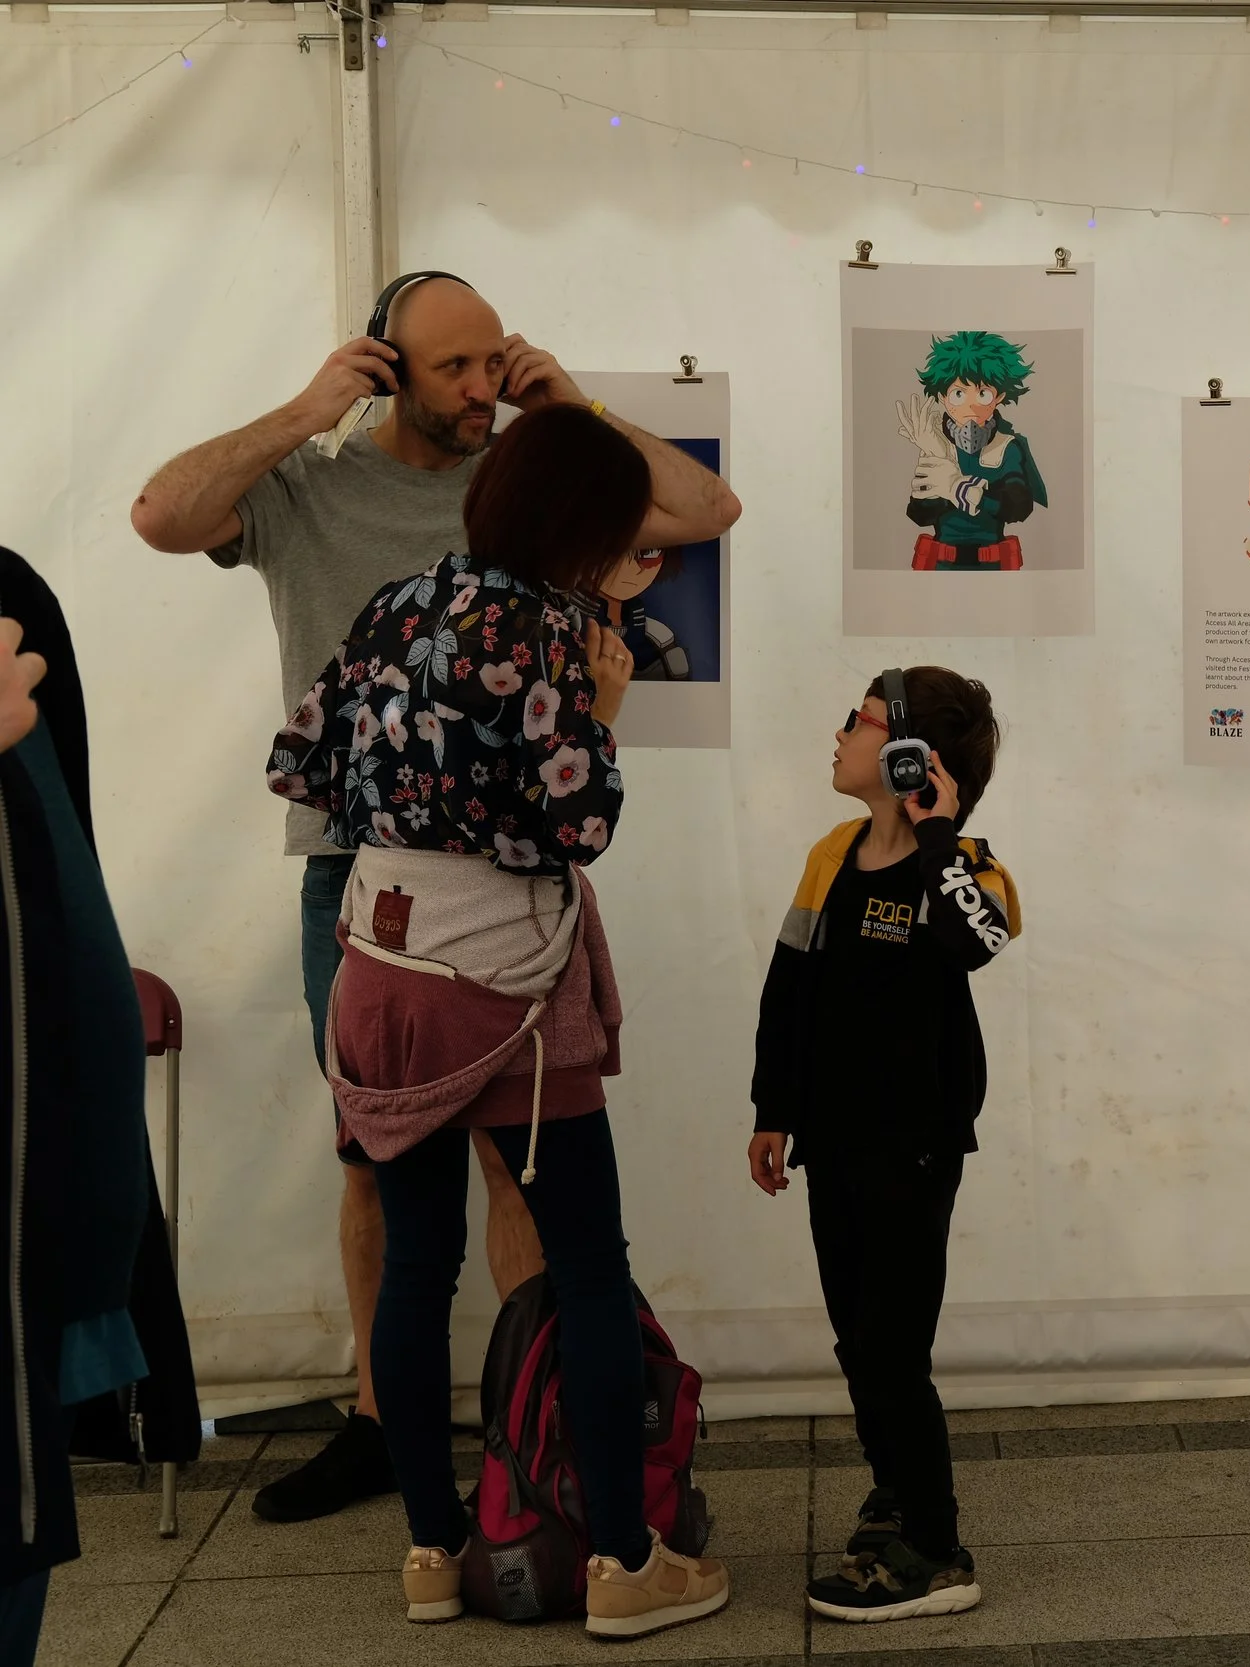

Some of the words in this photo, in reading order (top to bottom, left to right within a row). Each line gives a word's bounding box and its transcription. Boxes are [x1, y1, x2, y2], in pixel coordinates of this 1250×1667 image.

[1205, 655, 1231, 664] Through
[1209, 727, 1243, 738] BLAZE
[865, 897, 913, 928] PQA
[862, 919, 873, 929] BE
[873, 922, 911, 936] YOURSELF
[860, 928, 871, 937] BE
[871, 931, 909, 944] AMAZING
